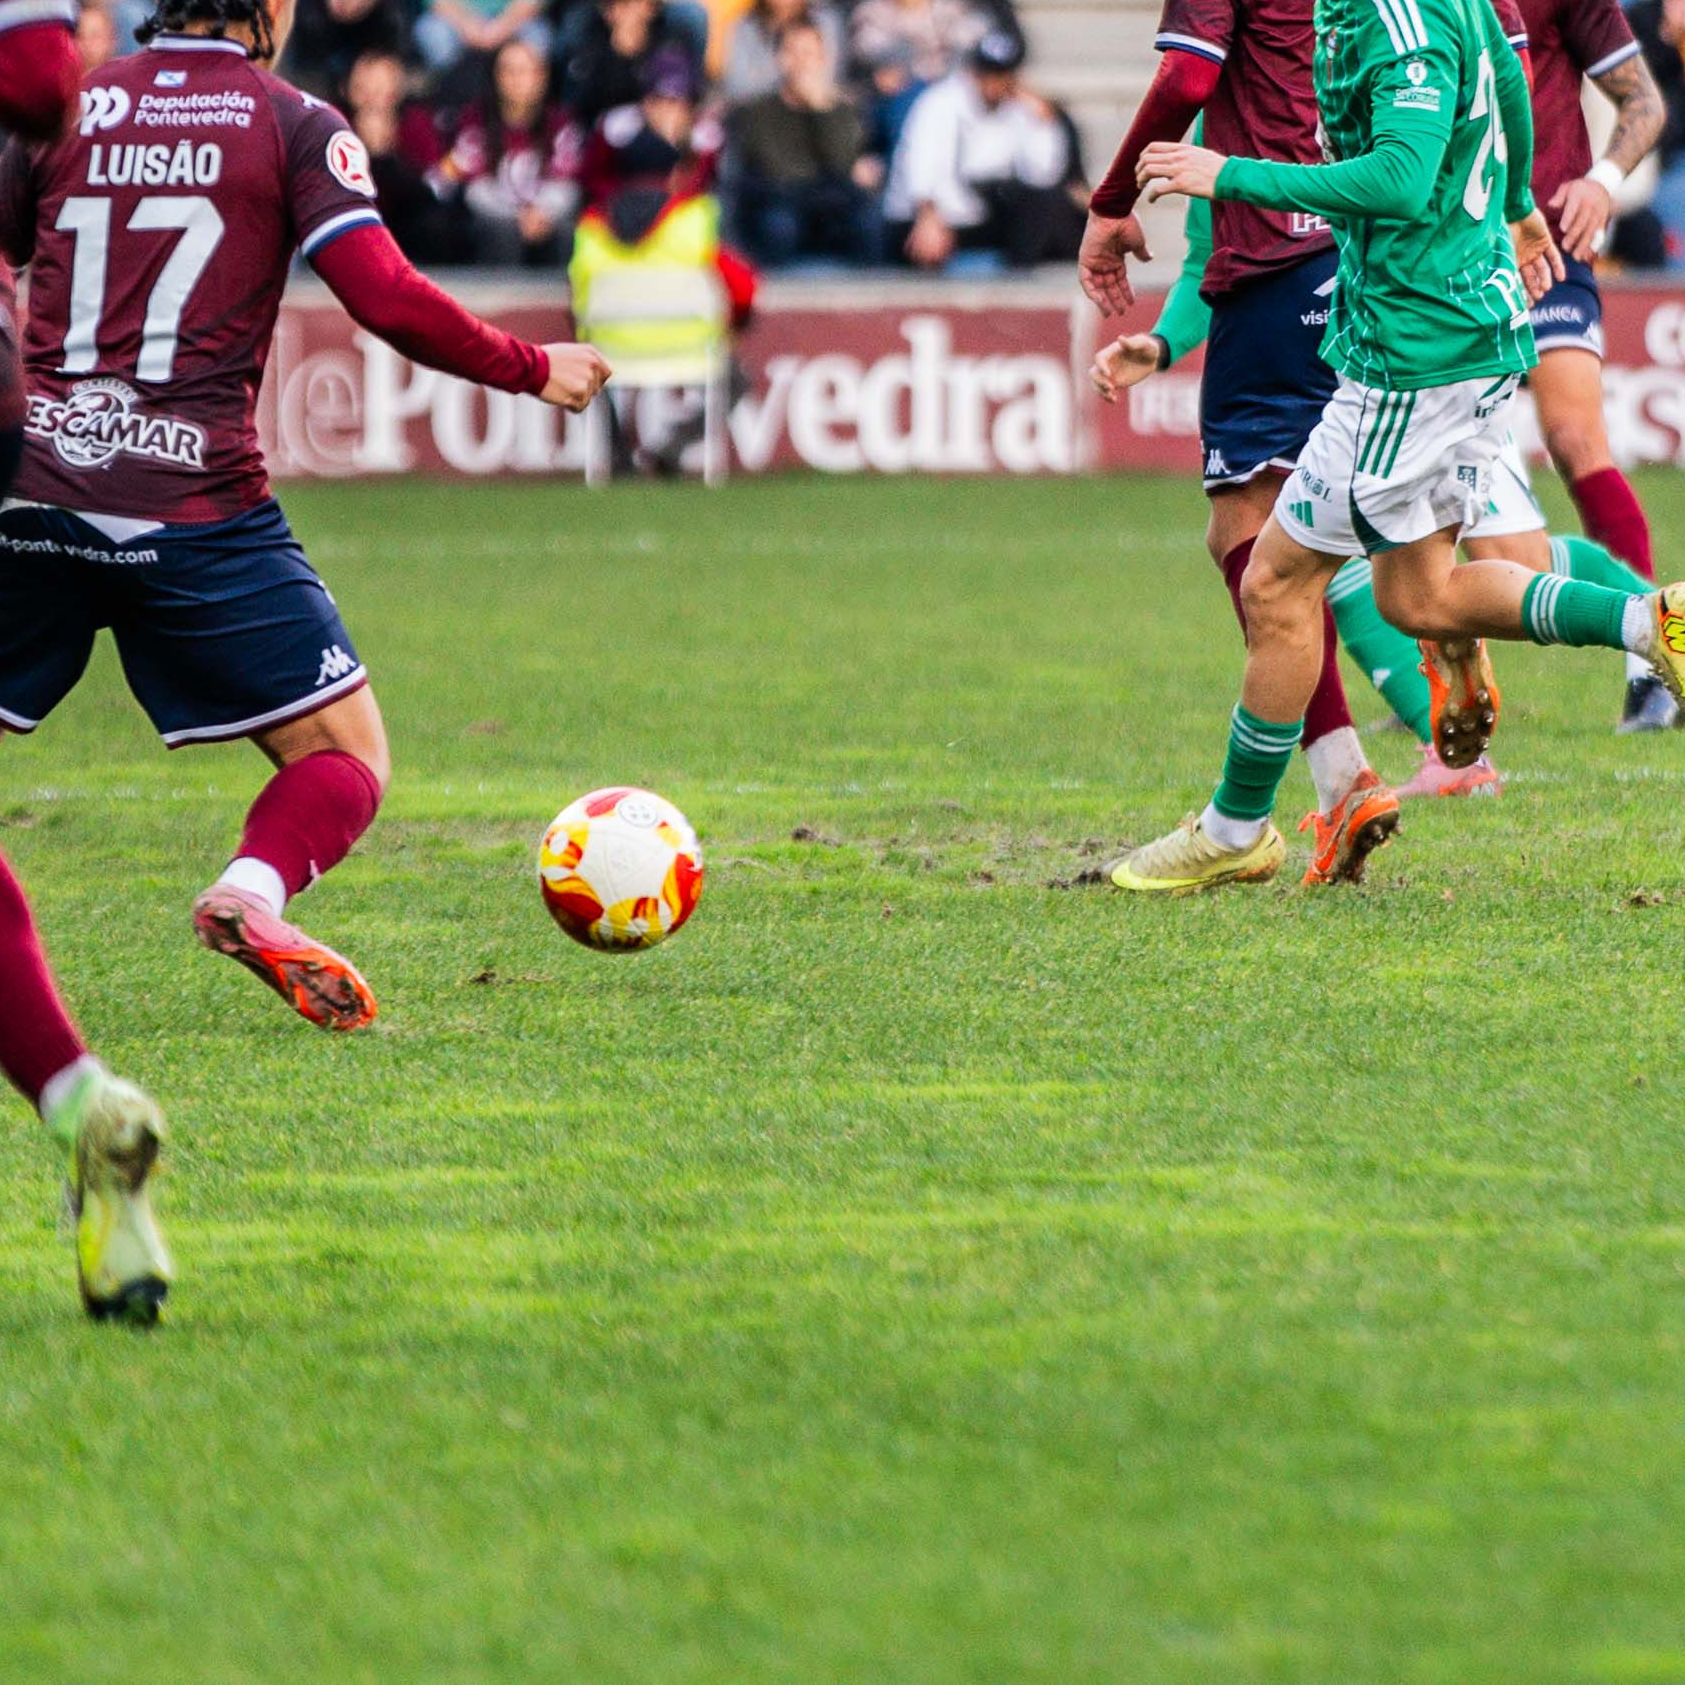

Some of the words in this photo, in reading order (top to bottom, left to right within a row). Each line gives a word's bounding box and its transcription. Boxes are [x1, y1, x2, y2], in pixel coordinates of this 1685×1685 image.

[134, 108, 252, 128] Pontevedra
[138, 90, 256, 112] Deputación
[87, 141, 222, 186] LUISÃO
[55, 195, 225, 384] 17
[24, 395, 207, 468] ESCAMAR
